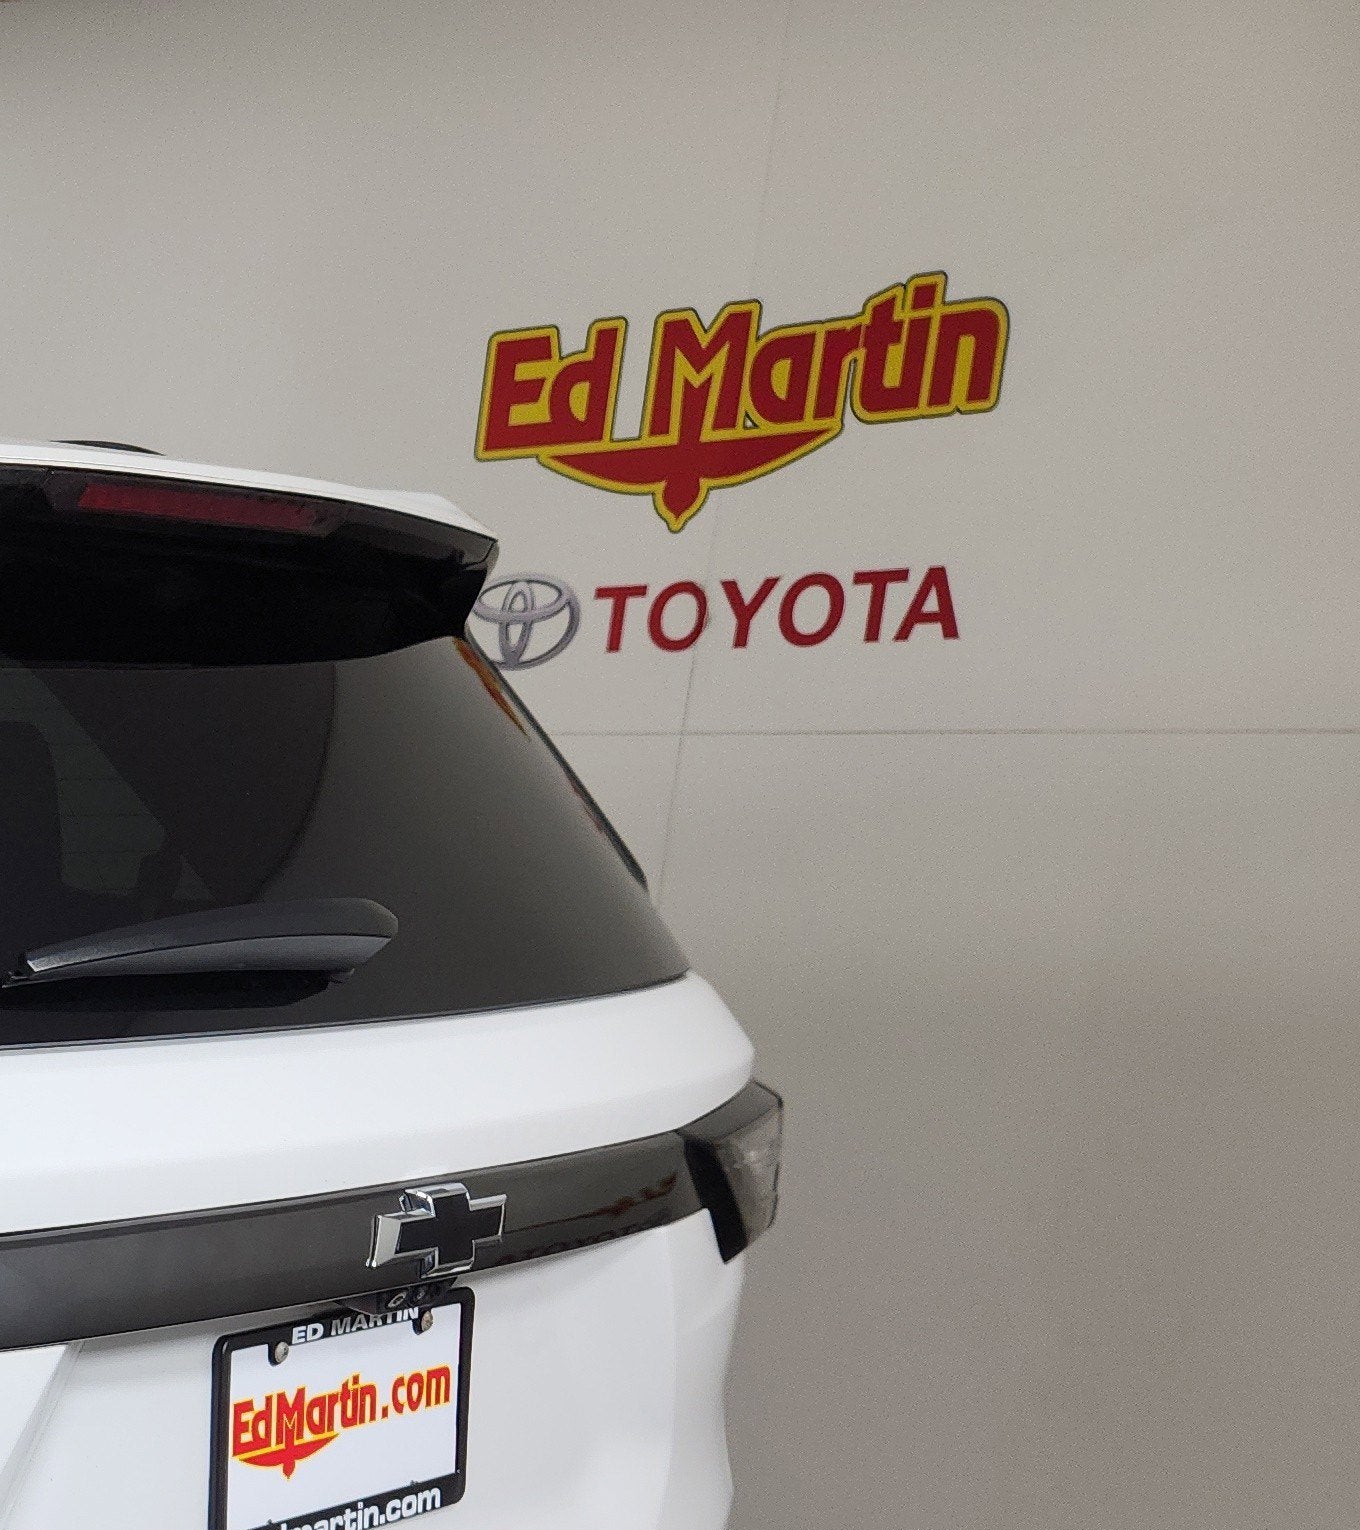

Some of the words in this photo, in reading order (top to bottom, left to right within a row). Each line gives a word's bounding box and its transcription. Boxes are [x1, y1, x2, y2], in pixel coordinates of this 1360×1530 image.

[476, 317, 626, 460] Ed
[641, 271, 1010, 437] Martin
[594, 565, 961, 654] TOYOTA
[291, 1324, 324, 1345] ED
